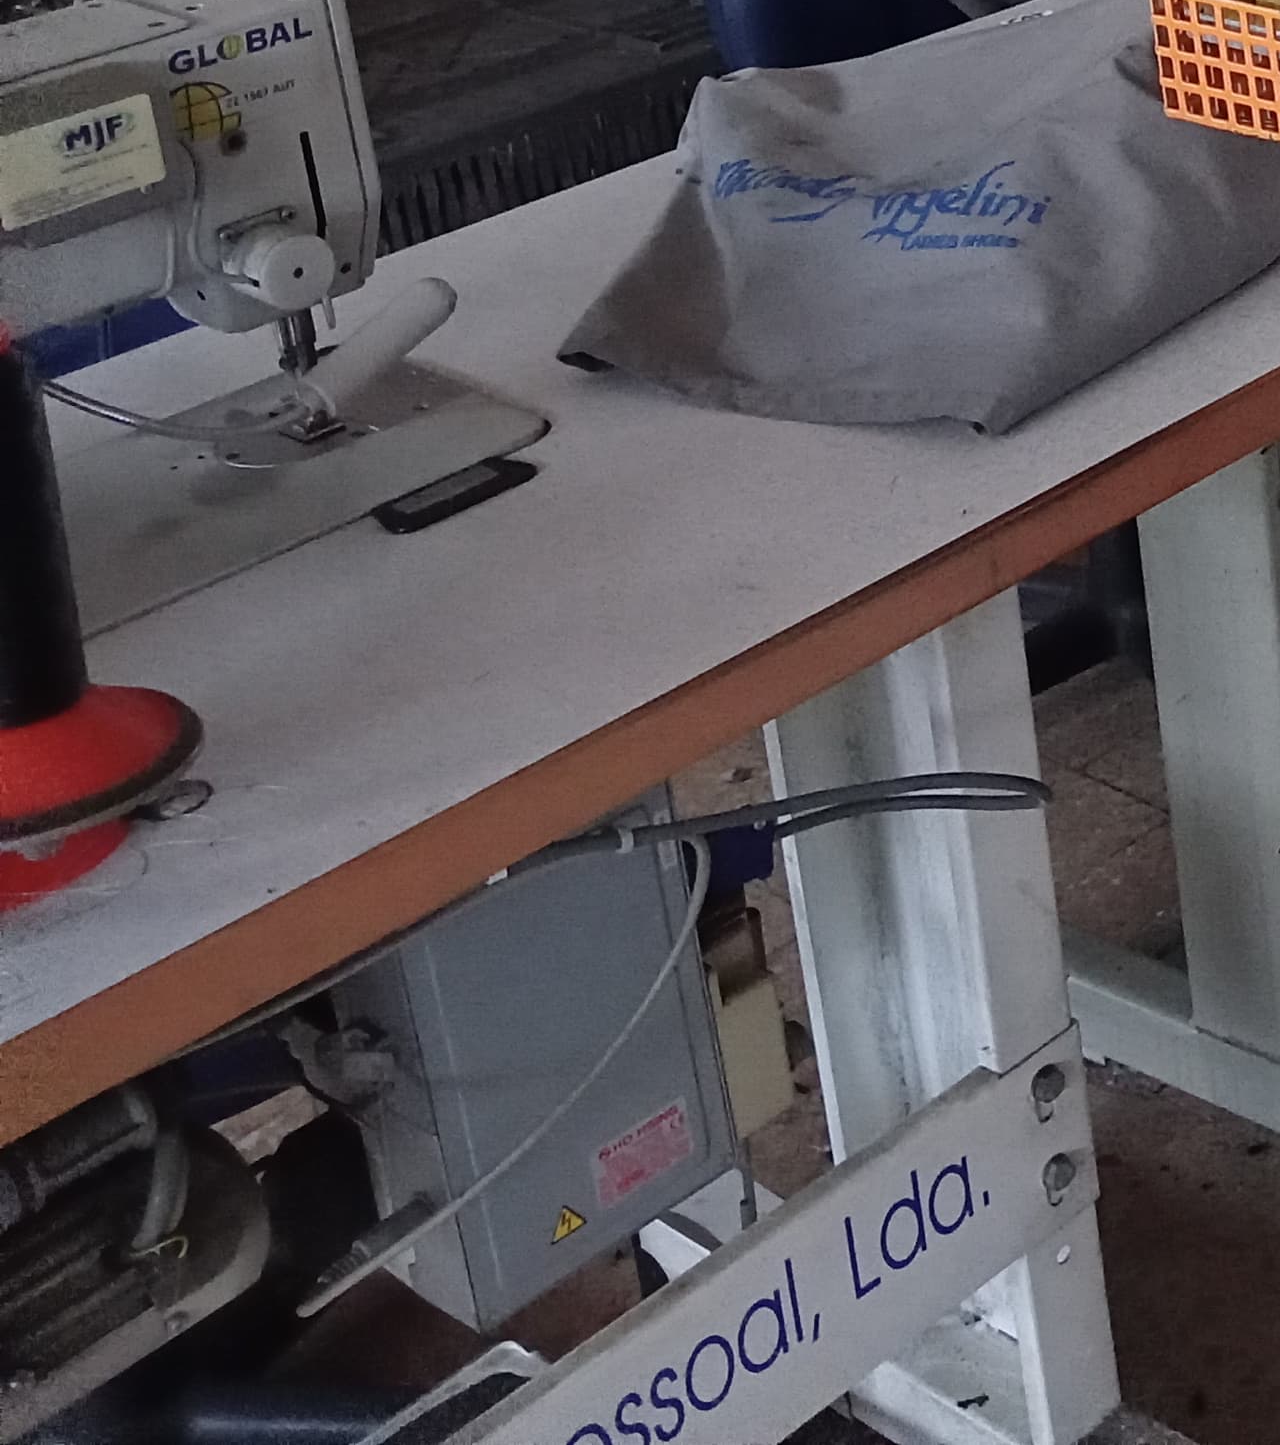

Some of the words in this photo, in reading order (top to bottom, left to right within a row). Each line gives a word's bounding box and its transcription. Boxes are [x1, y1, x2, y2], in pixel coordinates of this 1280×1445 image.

[168, 17, 313, 74] GLOBAL
[66, 114, 124, 152] MJF
[845, 1155, 991, 1300] Lda.
[564, 1257, 821, 1445] ssoal,
